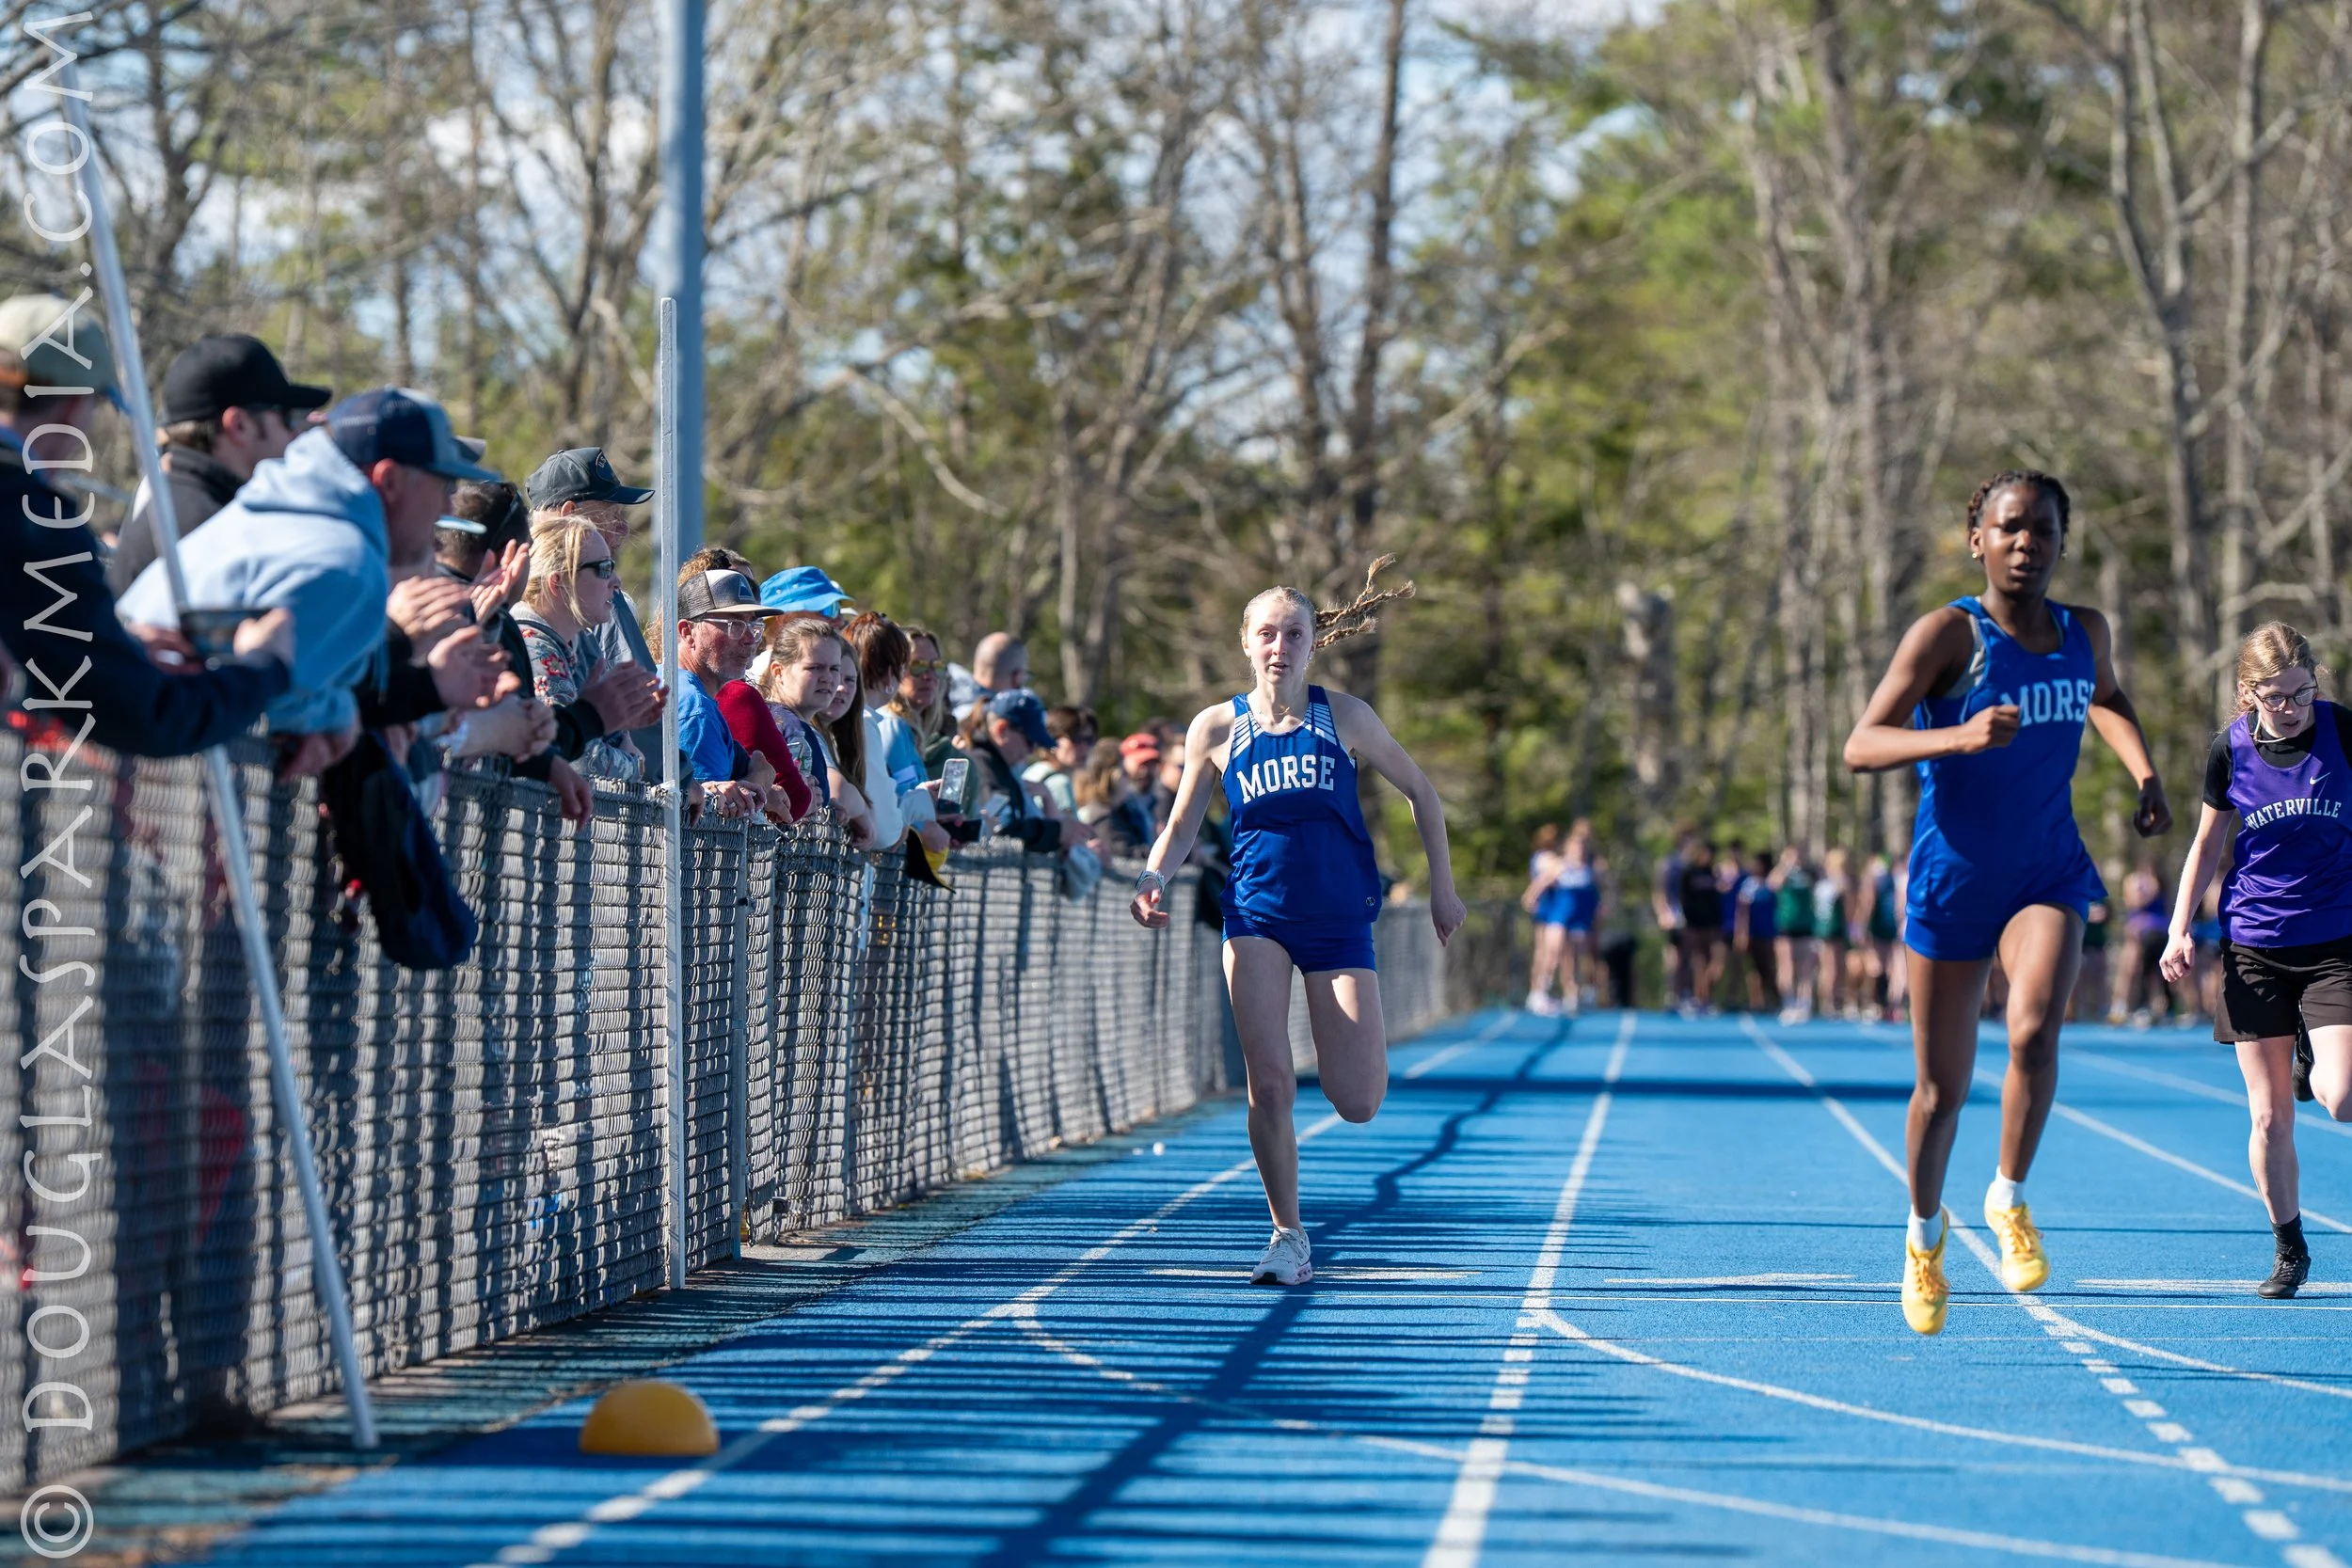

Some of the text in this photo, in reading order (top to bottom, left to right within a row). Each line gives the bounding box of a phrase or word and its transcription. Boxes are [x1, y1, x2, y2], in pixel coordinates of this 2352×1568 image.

[2000, 678, 2096, 727] MORS
[1236, 754, 1335, 804] MORSE
[2245, 798, 2342, 830] WATERVILLE
